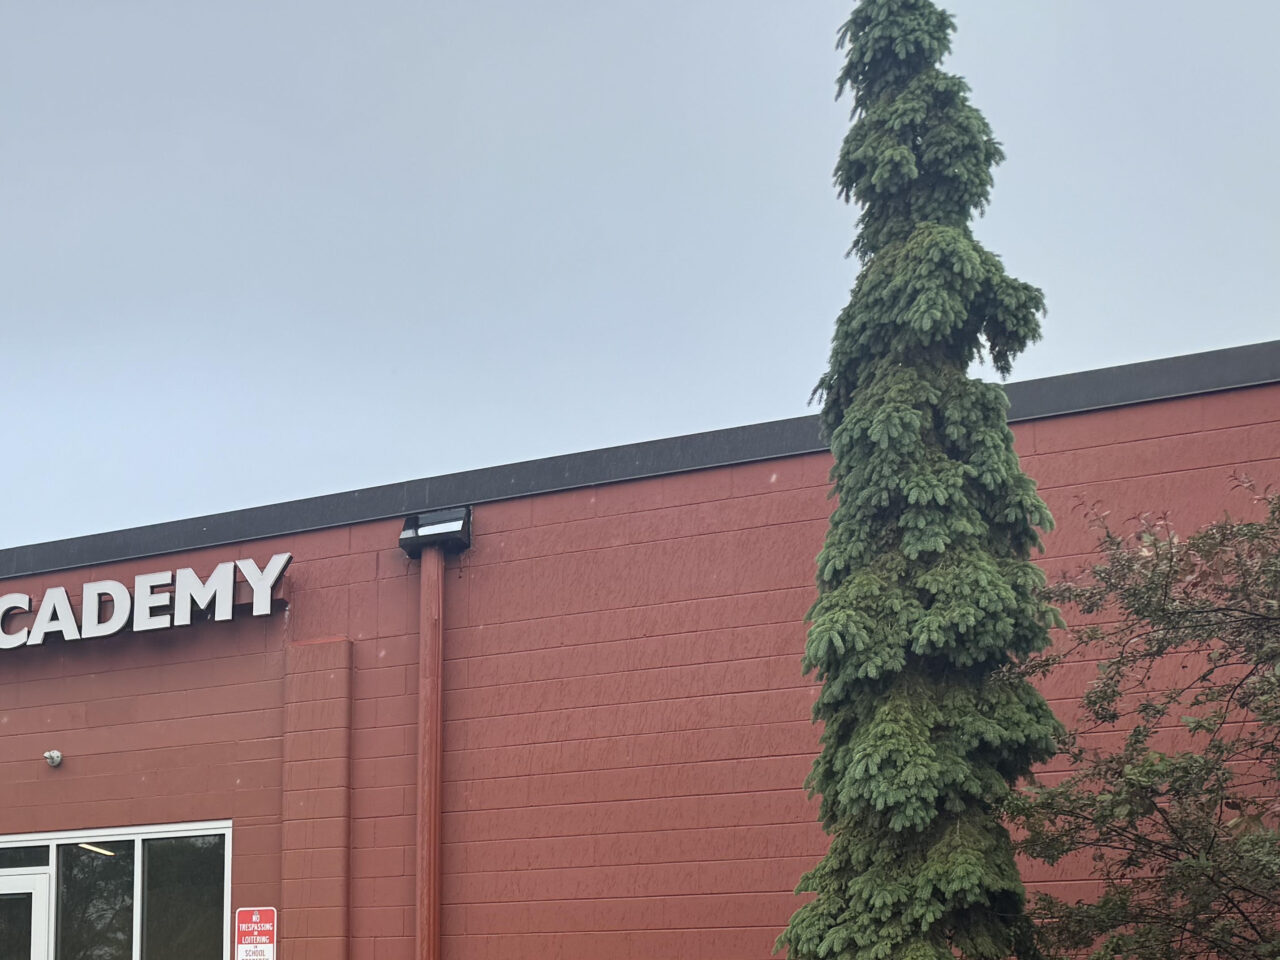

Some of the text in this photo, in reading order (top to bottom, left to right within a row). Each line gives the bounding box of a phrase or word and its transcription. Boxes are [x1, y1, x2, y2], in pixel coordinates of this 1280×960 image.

[239, 923, 273, 931] TRESPASSING
[242, 936, 270, 944] LOITERING
[245, 949, 265, 957] SCHOOL
